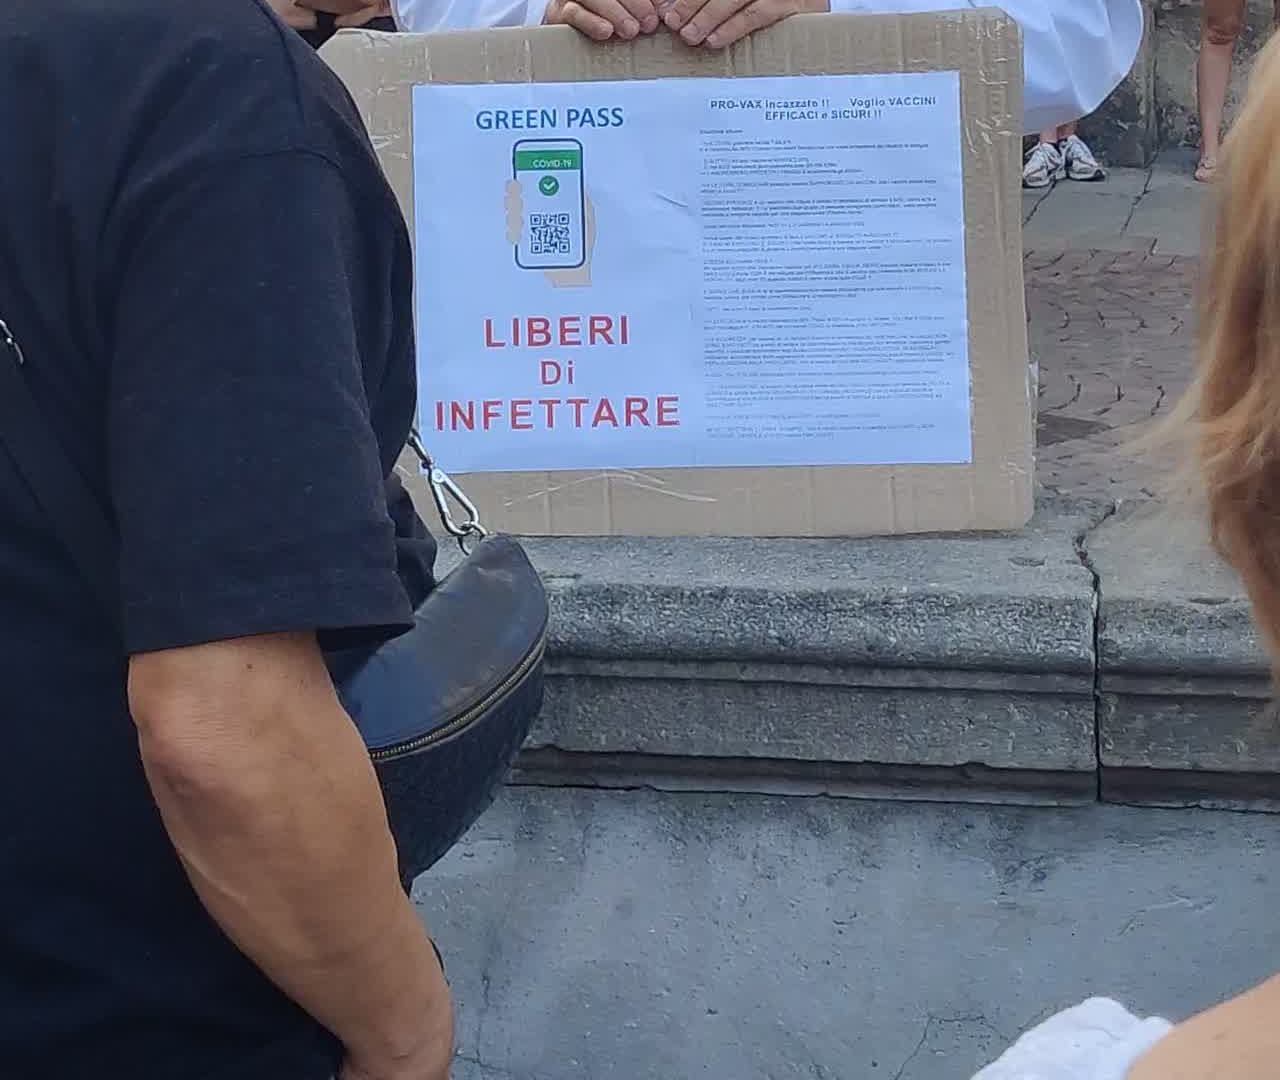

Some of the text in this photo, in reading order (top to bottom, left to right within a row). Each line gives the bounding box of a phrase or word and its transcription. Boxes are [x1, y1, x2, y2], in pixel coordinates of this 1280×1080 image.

[710, 99, 762, 110] PRO-VAX
[849, 97, 886, 109] Voglio
[888, 96, 936, 107] VACCINI
[475, 107, 624, 130] GREEN PASS
[765, 110, 819, 121] EFFICACI
[831, 109, 871, 120] SICURI
[532, 159, 572, 169] COVID-19
[485, 315, 628, 348] LIBERI
[540, 360, 574, 385] Di
[436, 396, 680, 432] INFETTARE
